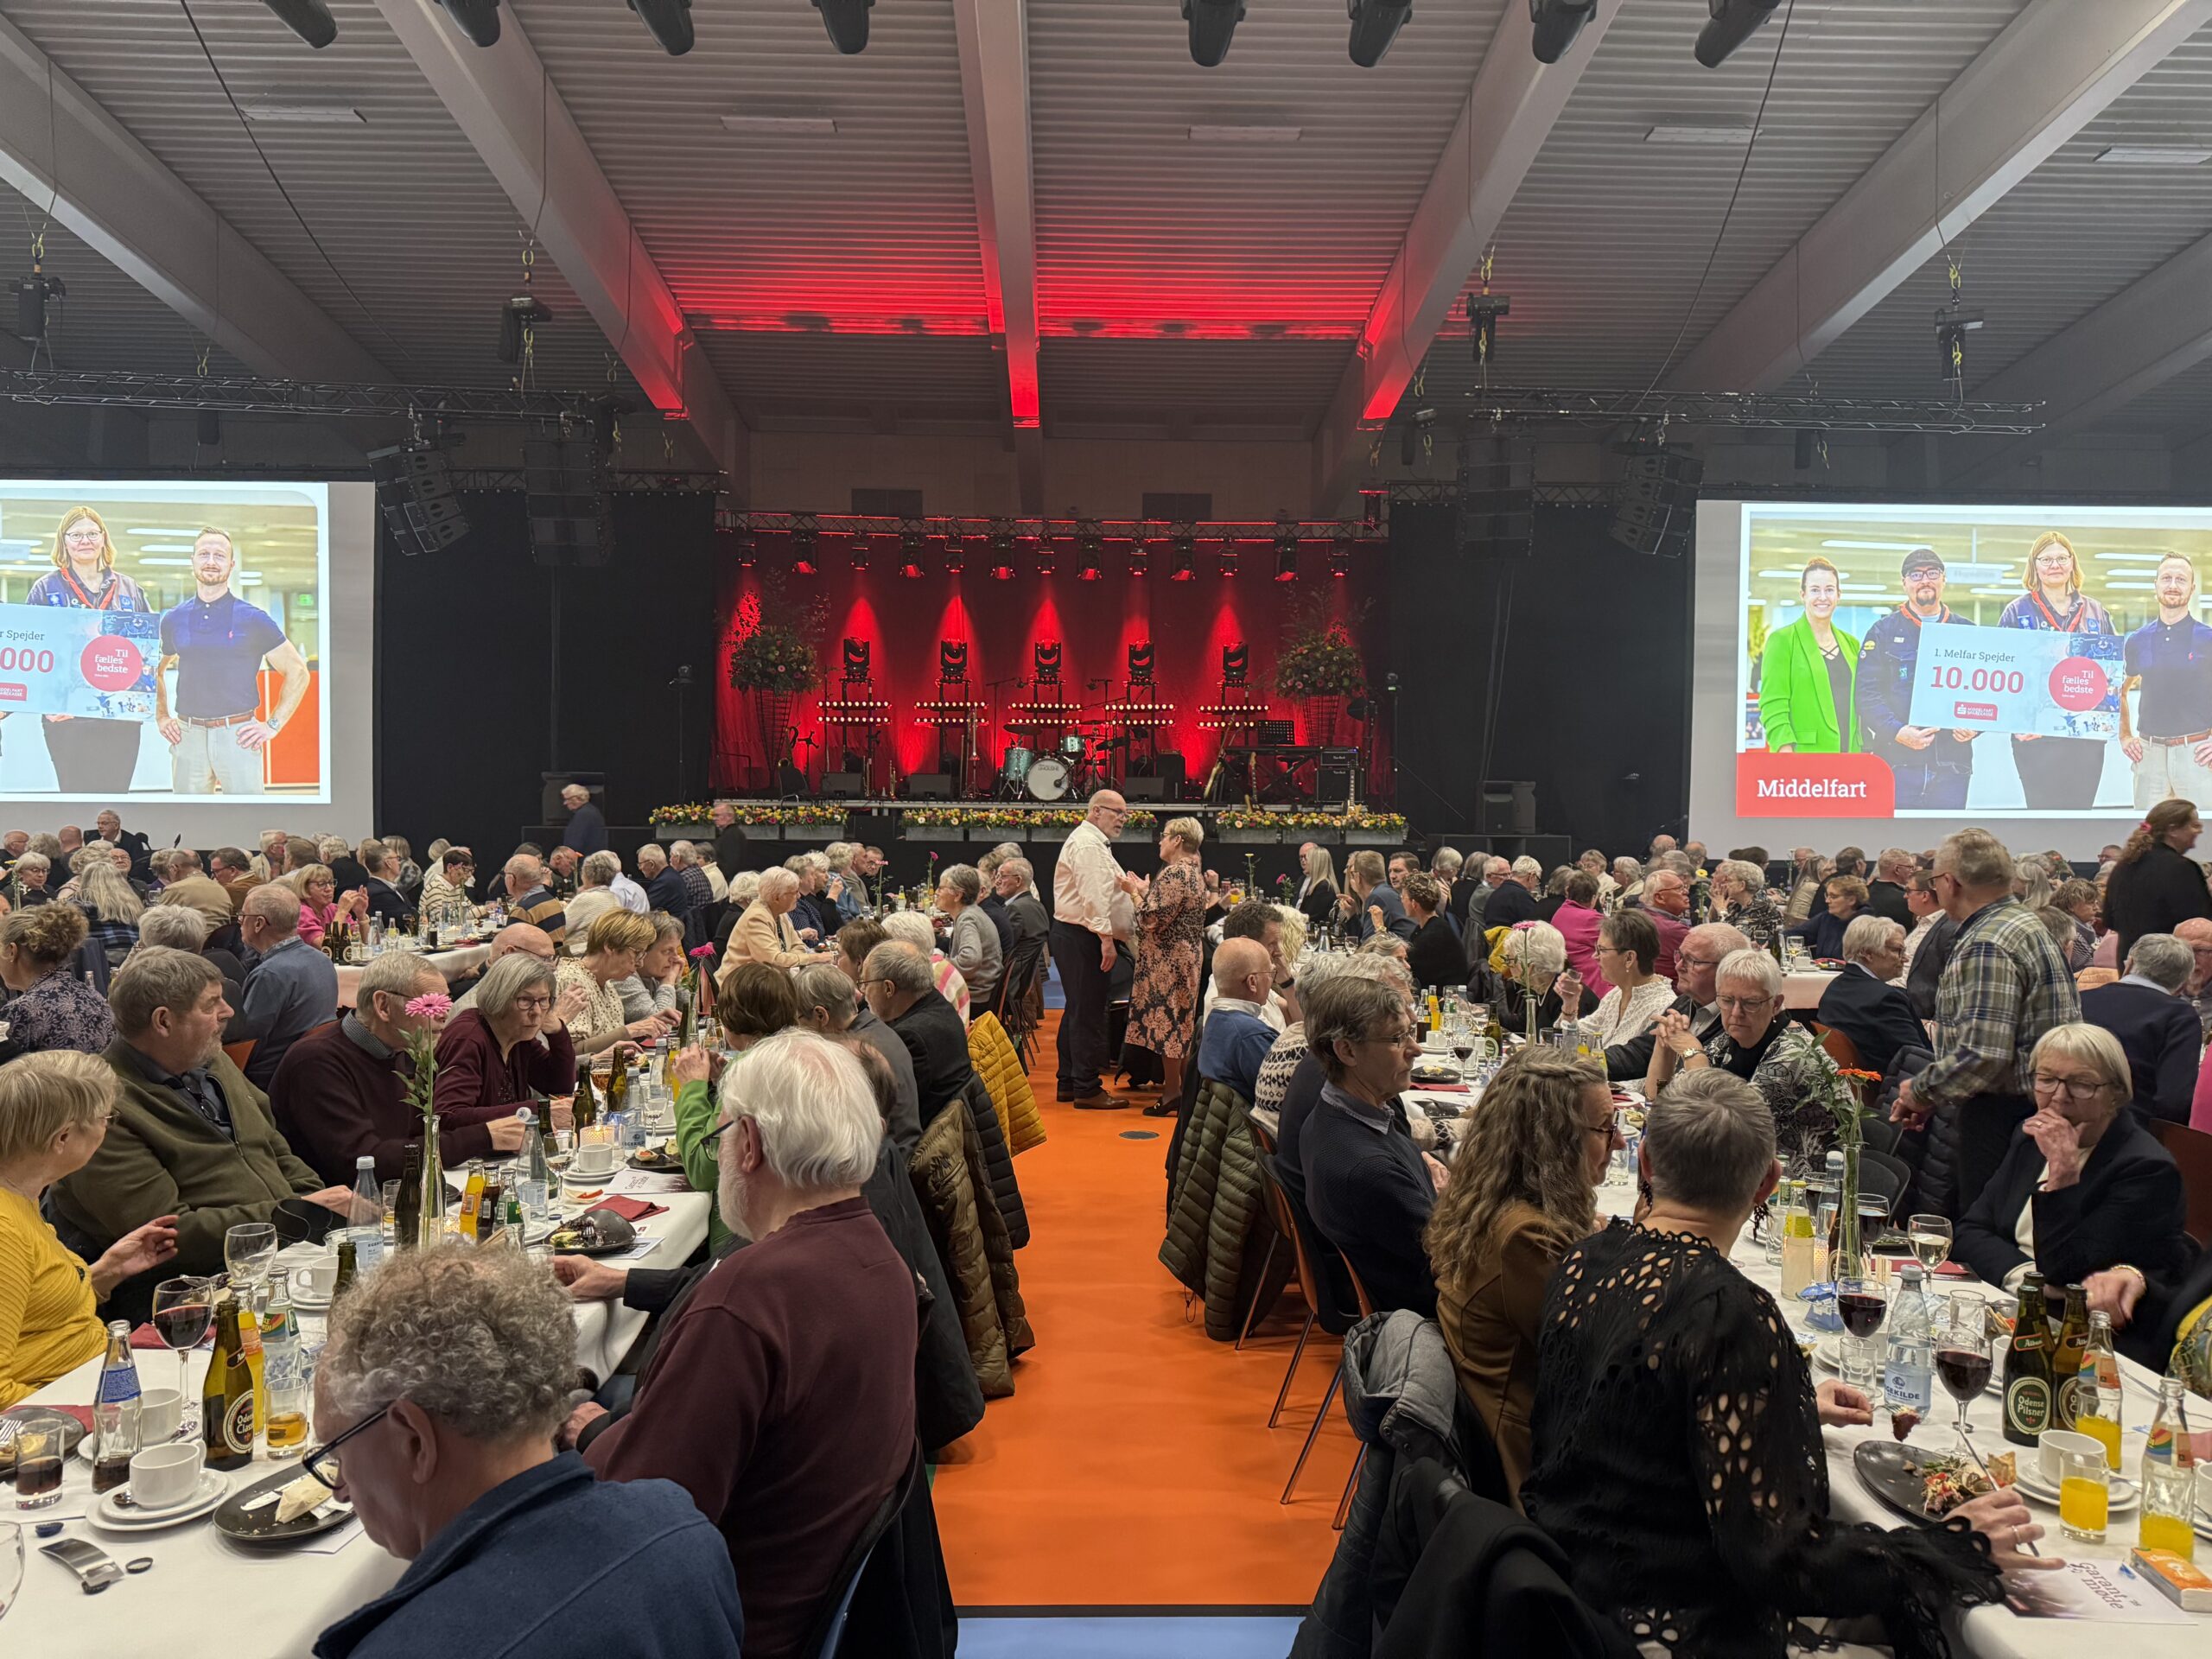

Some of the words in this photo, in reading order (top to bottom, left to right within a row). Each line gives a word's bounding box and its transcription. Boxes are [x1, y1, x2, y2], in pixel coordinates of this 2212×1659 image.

[6, 630, 45, 641] Spejder
[0, 646, 54, 673] 000
[94, 654, 124, 664] fælles
[115, 649, 129, 658] Til
[1935, 648, 1942, 657] 1.
[1944, 649, 1976, 660] Melfar
[1979, 651, 2016, 664] Spejder
[96, 663, 129, 674] bedste
[2081, 670, 2094, 679] Til
[1930, 665, 2024, 694] 10.000
[2062, 675, 2089, 685] fælles
[2063, 683, 2094, 695] bedste
[1757, 779, 1867, 798] Middelfart
[2018, 1395, 2044, 1408] Odense
[2018, 1404, 2045, 1417] Pilsner
